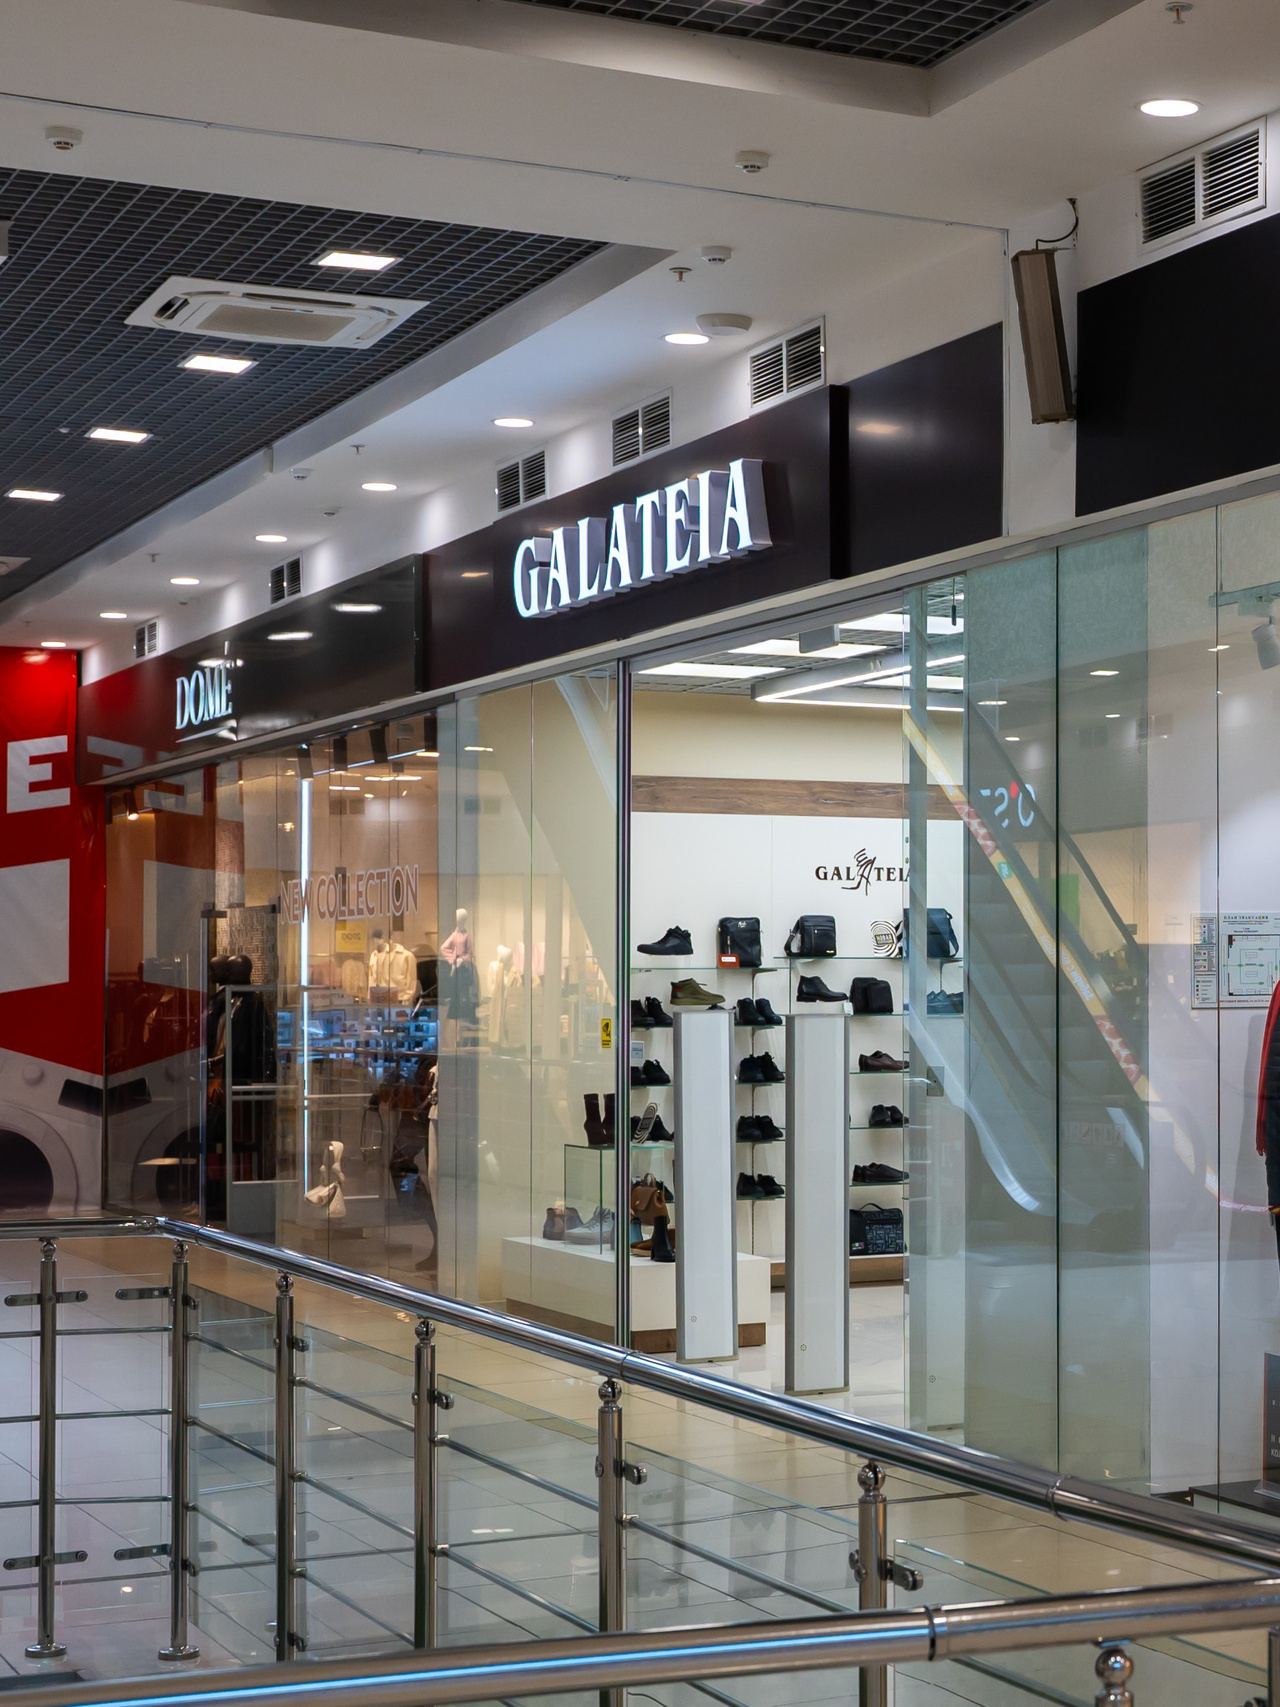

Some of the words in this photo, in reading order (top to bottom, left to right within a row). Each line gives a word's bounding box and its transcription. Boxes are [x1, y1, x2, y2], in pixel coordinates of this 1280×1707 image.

[513, 457, 767, 618] GALATEIA
[280, 878, 314, 925] NEW
[316, 864, 420, 923] COLLECTION
